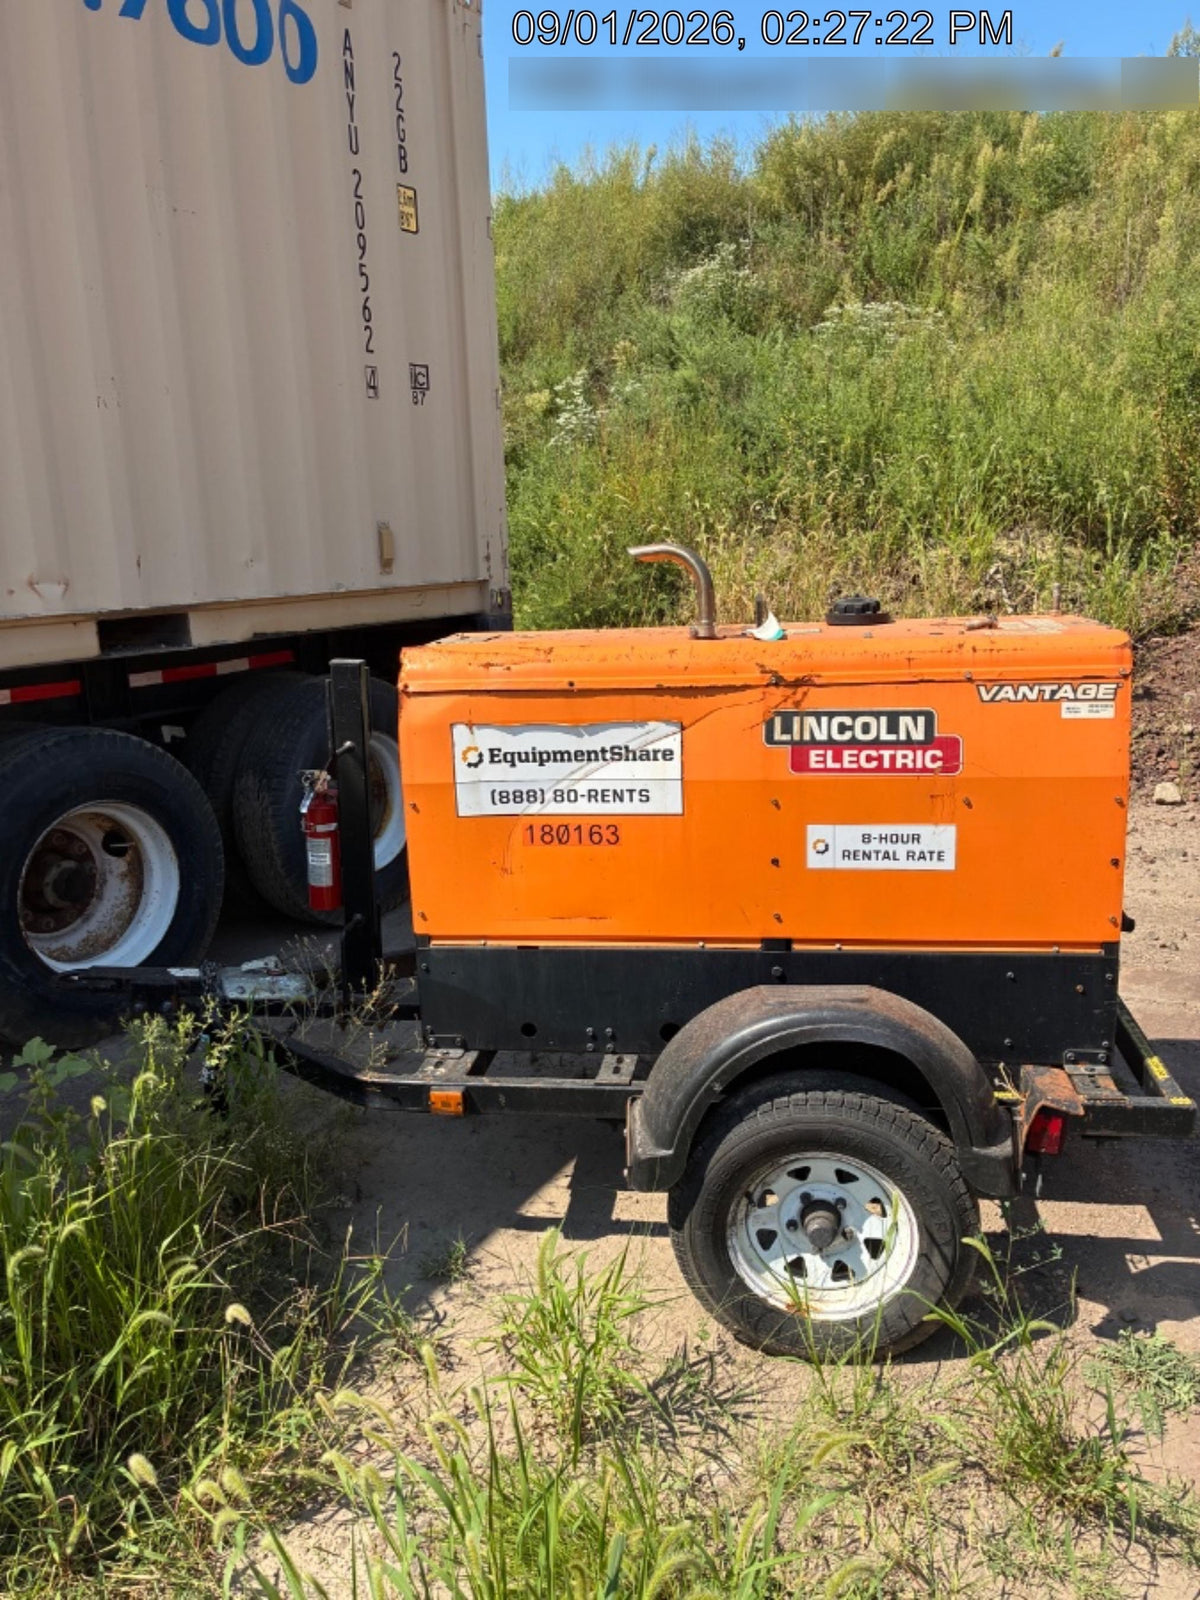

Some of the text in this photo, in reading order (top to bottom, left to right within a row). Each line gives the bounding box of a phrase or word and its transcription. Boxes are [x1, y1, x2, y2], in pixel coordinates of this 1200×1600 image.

[343, 28, 359, 155] ANYU
[352, 168, 374, 353] 209562
[412, 391, 426, 406] 87
[976, 683, 1117, 702] VANTAGE
[773, 715, 926, 741] LINCOLN
[488, 745, 675, 767] EquipmentShare
[809, 749, 943, 769] ELECTRIC
[490, 788, 650, 805] (888) 80-RENTS
[525, 824, 620, 845] 180163
[861, 833, 921, 844] 8-HOUR
[842, 849, 945, 861] RENTAL RATE
